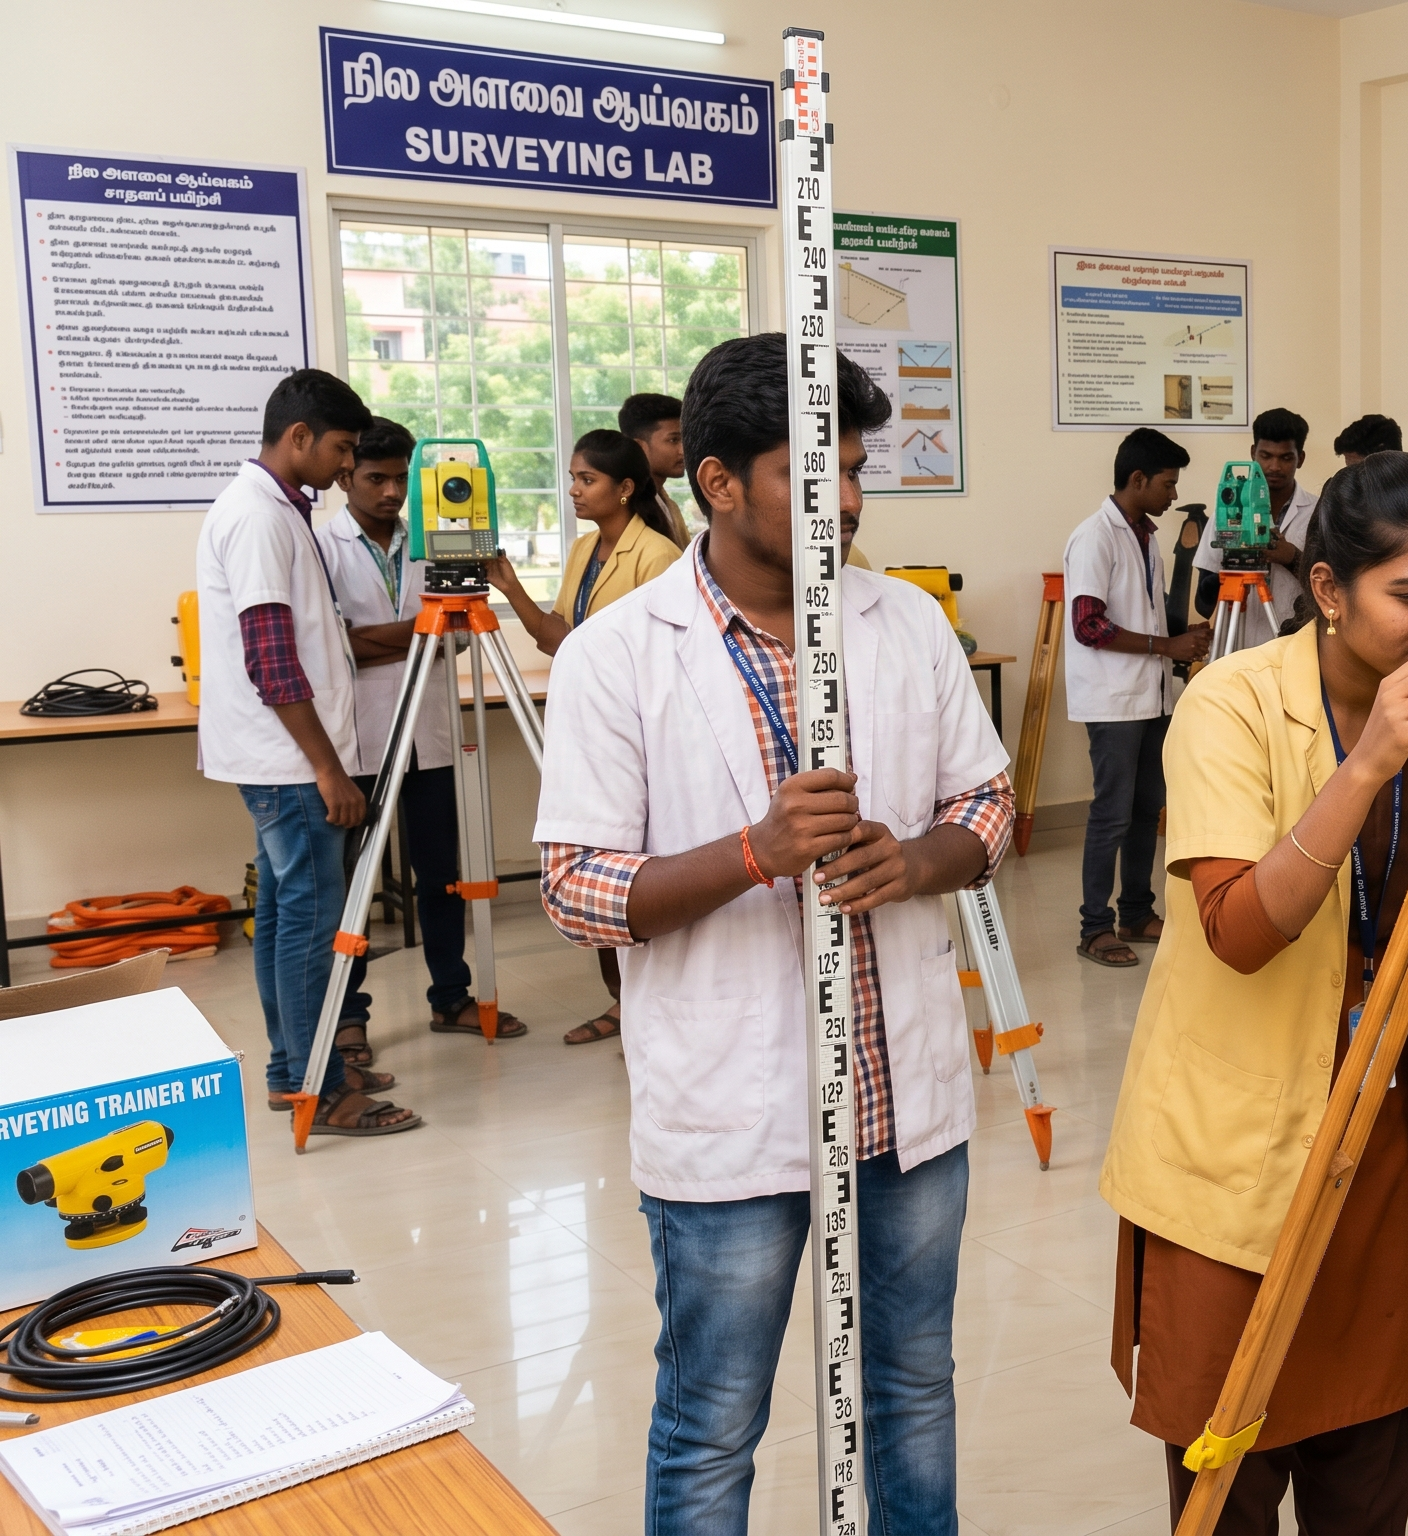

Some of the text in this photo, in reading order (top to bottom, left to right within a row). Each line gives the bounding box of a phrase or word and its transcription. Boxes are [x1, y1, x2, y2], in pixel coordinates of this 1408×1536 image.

[342, 52, 420, 111] நில
[429, 68, 584, 119] அளவை
[592, 83, 759, 136] ஆய்வகம்
[405, 126, 714, 186] SURVEYING LAB
[803, 246, 827, 270] 240
[808, 384, 831, 406] 220
[806, 585, 829, 607] 462
[812, 652, 837, 675] 250
[95, 1081, 186, 1119] TRAINER
[192, 1072, 223, 1099] KIT
